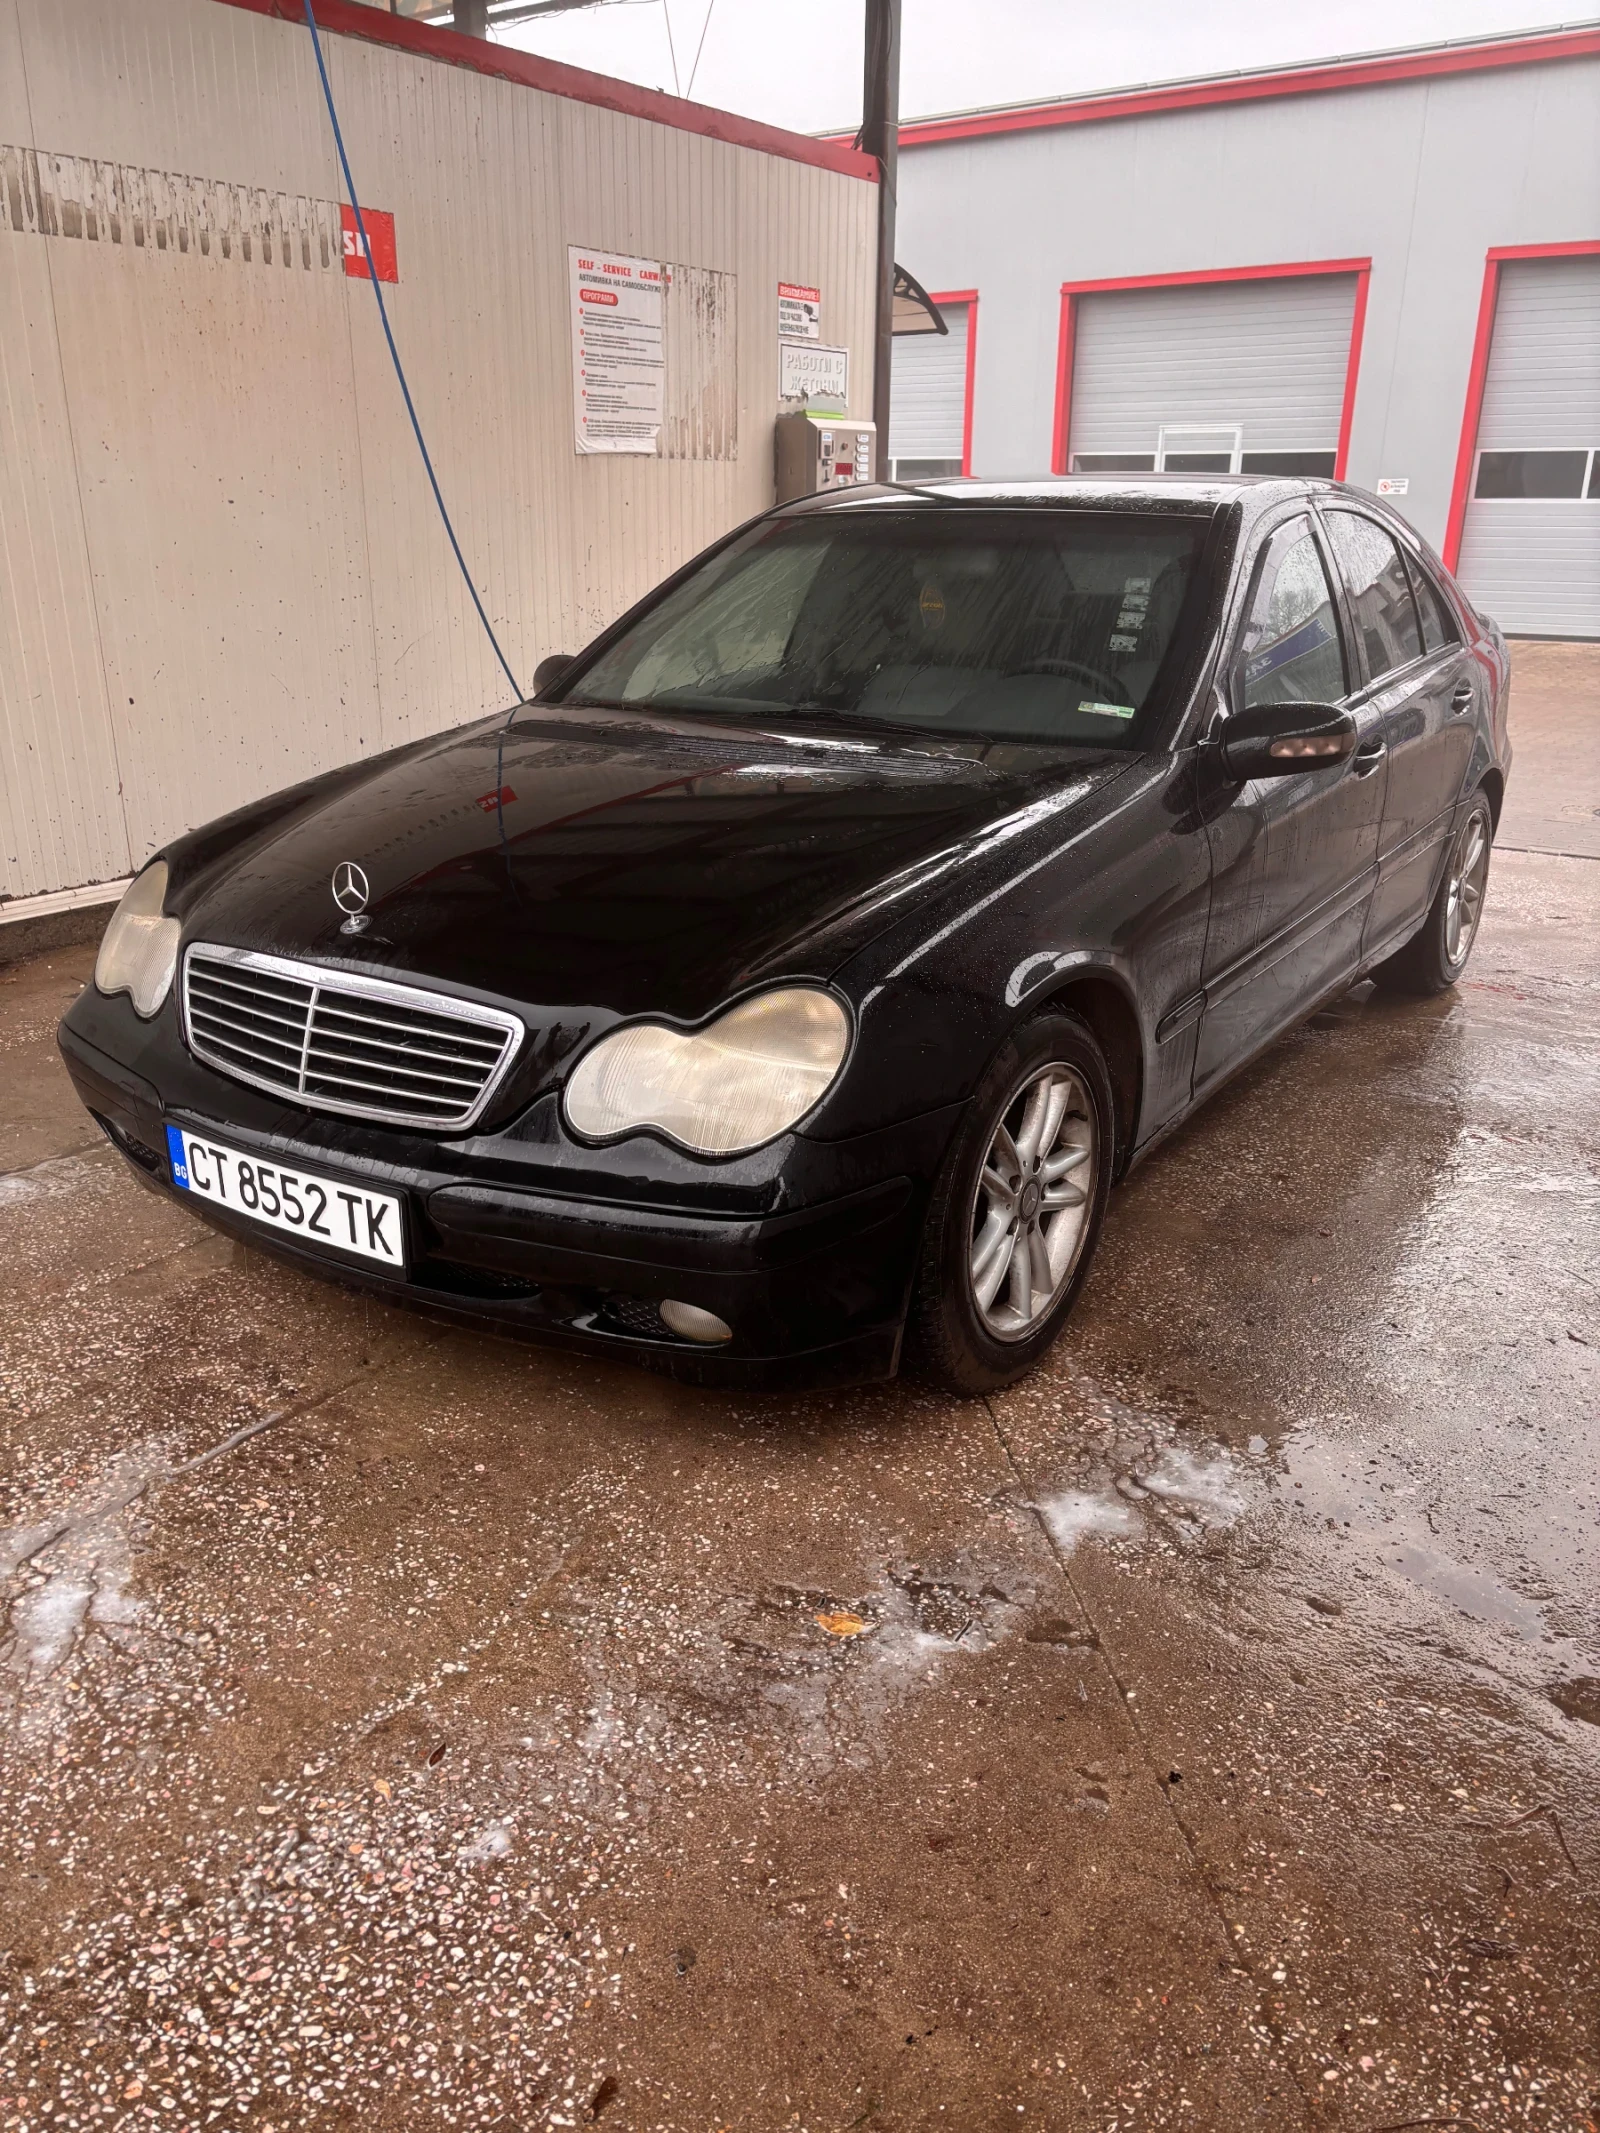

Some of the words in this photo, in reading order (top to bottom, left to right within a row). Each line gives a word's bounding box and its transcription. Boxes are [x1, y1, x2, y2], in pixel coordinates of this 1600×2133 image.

[578, 259, 594, 271] SELF
[603, 264, 632, 277] SERVICE
[613, 279, 621, 287] НА
[582, 290, 615, 303] ПРОГРАМИ
[786, 353, 832, 373] РАБОТИ
[836, 360, 843, 375] С
[174, 1162, 188, 1179] BG
[188, 1142, 228, 1199] CT
[237, 1160, 331, 1237] 8552
[336, 1190, 394, 1256] TK
